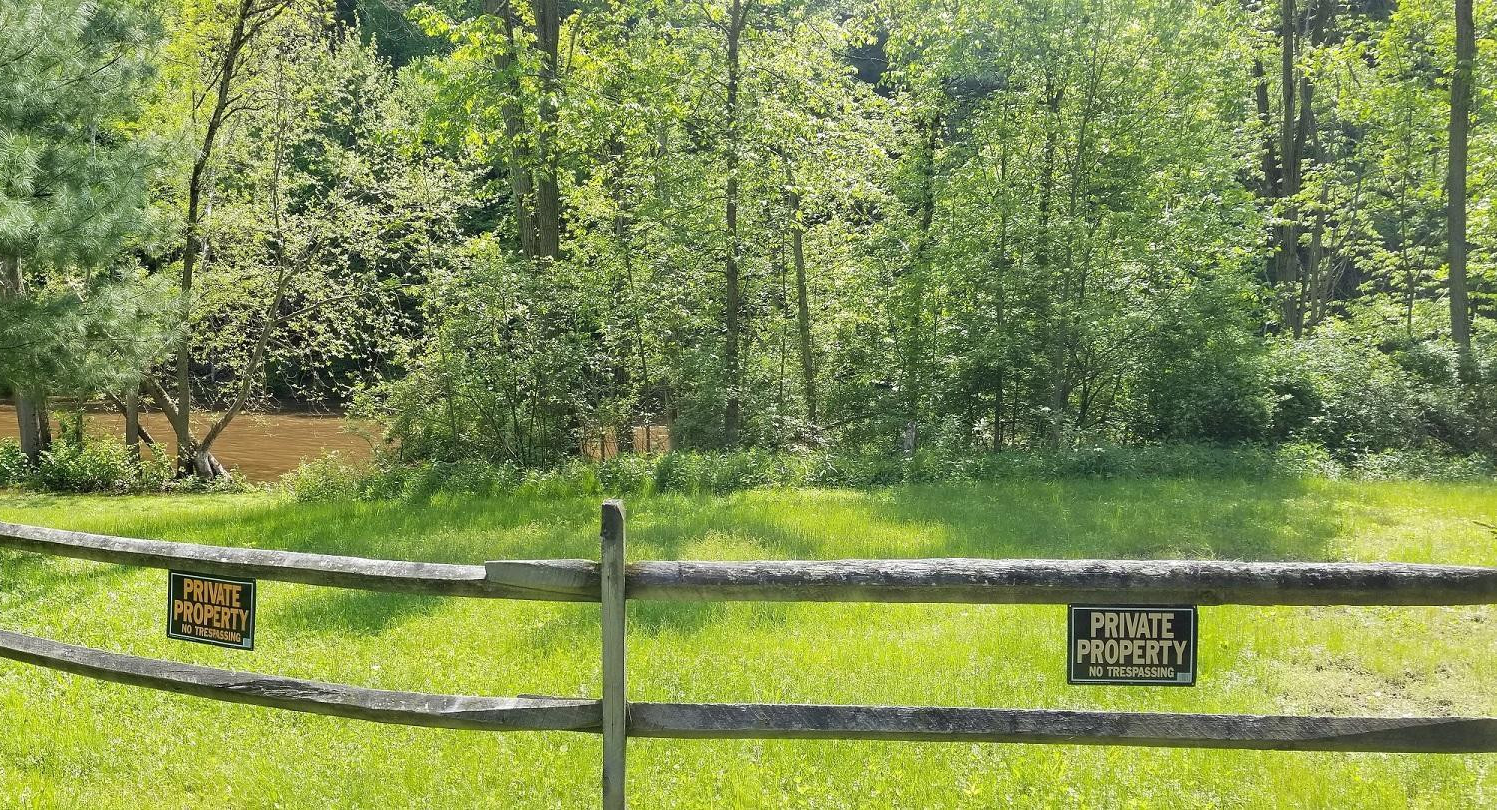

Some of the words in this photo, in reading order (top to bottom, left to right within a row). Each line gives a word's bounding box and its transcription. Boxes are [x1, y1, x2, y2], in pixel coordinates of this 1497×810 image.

[183, 578, 242, 608] PRIVATE
[173, 599, 250, 631] PROPERTY
[1090, 612, 1175, 639] PRIVATE
[181, 623, 193, 634] NO
[194, 625, 242, 643] TRESPASSING
[1076, 639, 1188, 665] PROPERTY
[1088, 665, 1104, 677] NO
[1106, 666, 1175, 678] TRESPASSING
